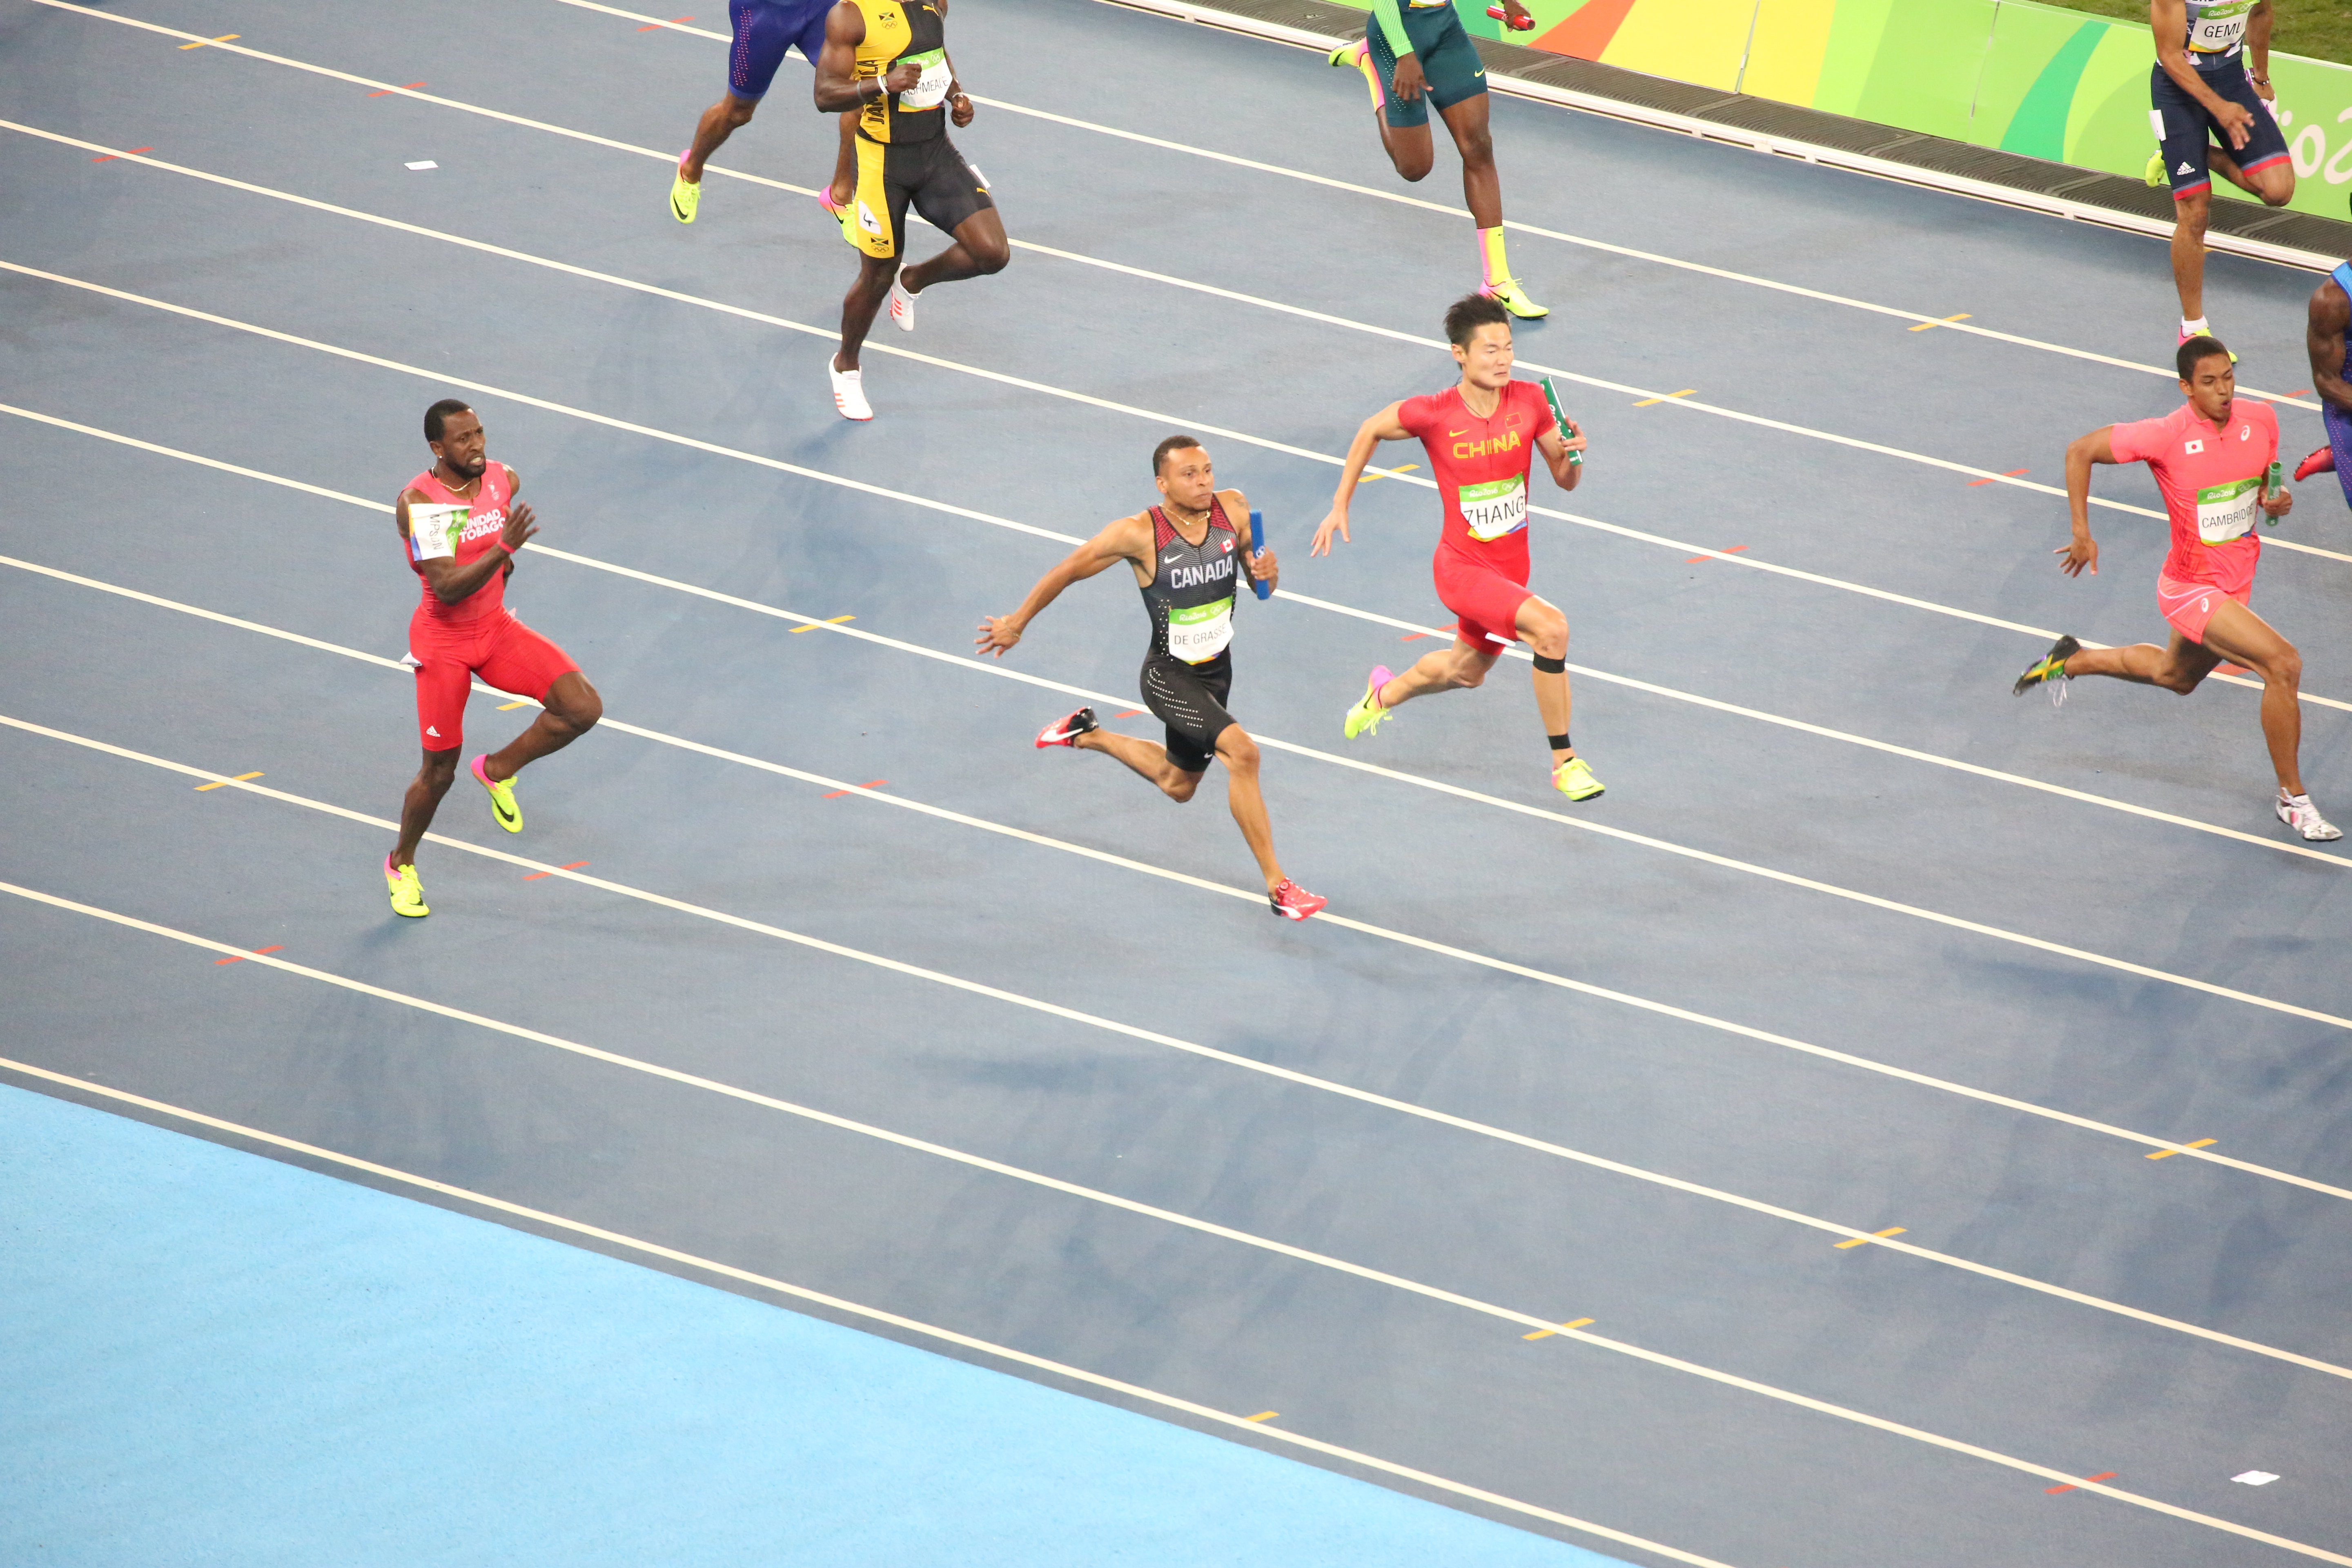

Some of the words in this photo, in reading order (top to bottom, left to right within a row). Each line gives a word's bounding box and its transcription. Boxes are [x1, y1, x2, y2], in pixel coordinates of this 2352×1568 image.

[2208, 8, 2234, 16] Rio2016
[1453, 430, 1521, 459] CHINA
[1469, 486, 1498, 497] Rio2016
[2207, 488, 2235, 499] Rio2016
[461, 509, 501, 531] INIDAD
[1463, 496, 1524, 527] ZHANG
[430, 514, 444, 550] MPSON
[1171, 555, 1233, 589] CANADA
[1179, 610, 1207, 621] Rio2016
[1174, 635, 1189, 645] DE
[1193, 623, 1227, 644] GRASSE
